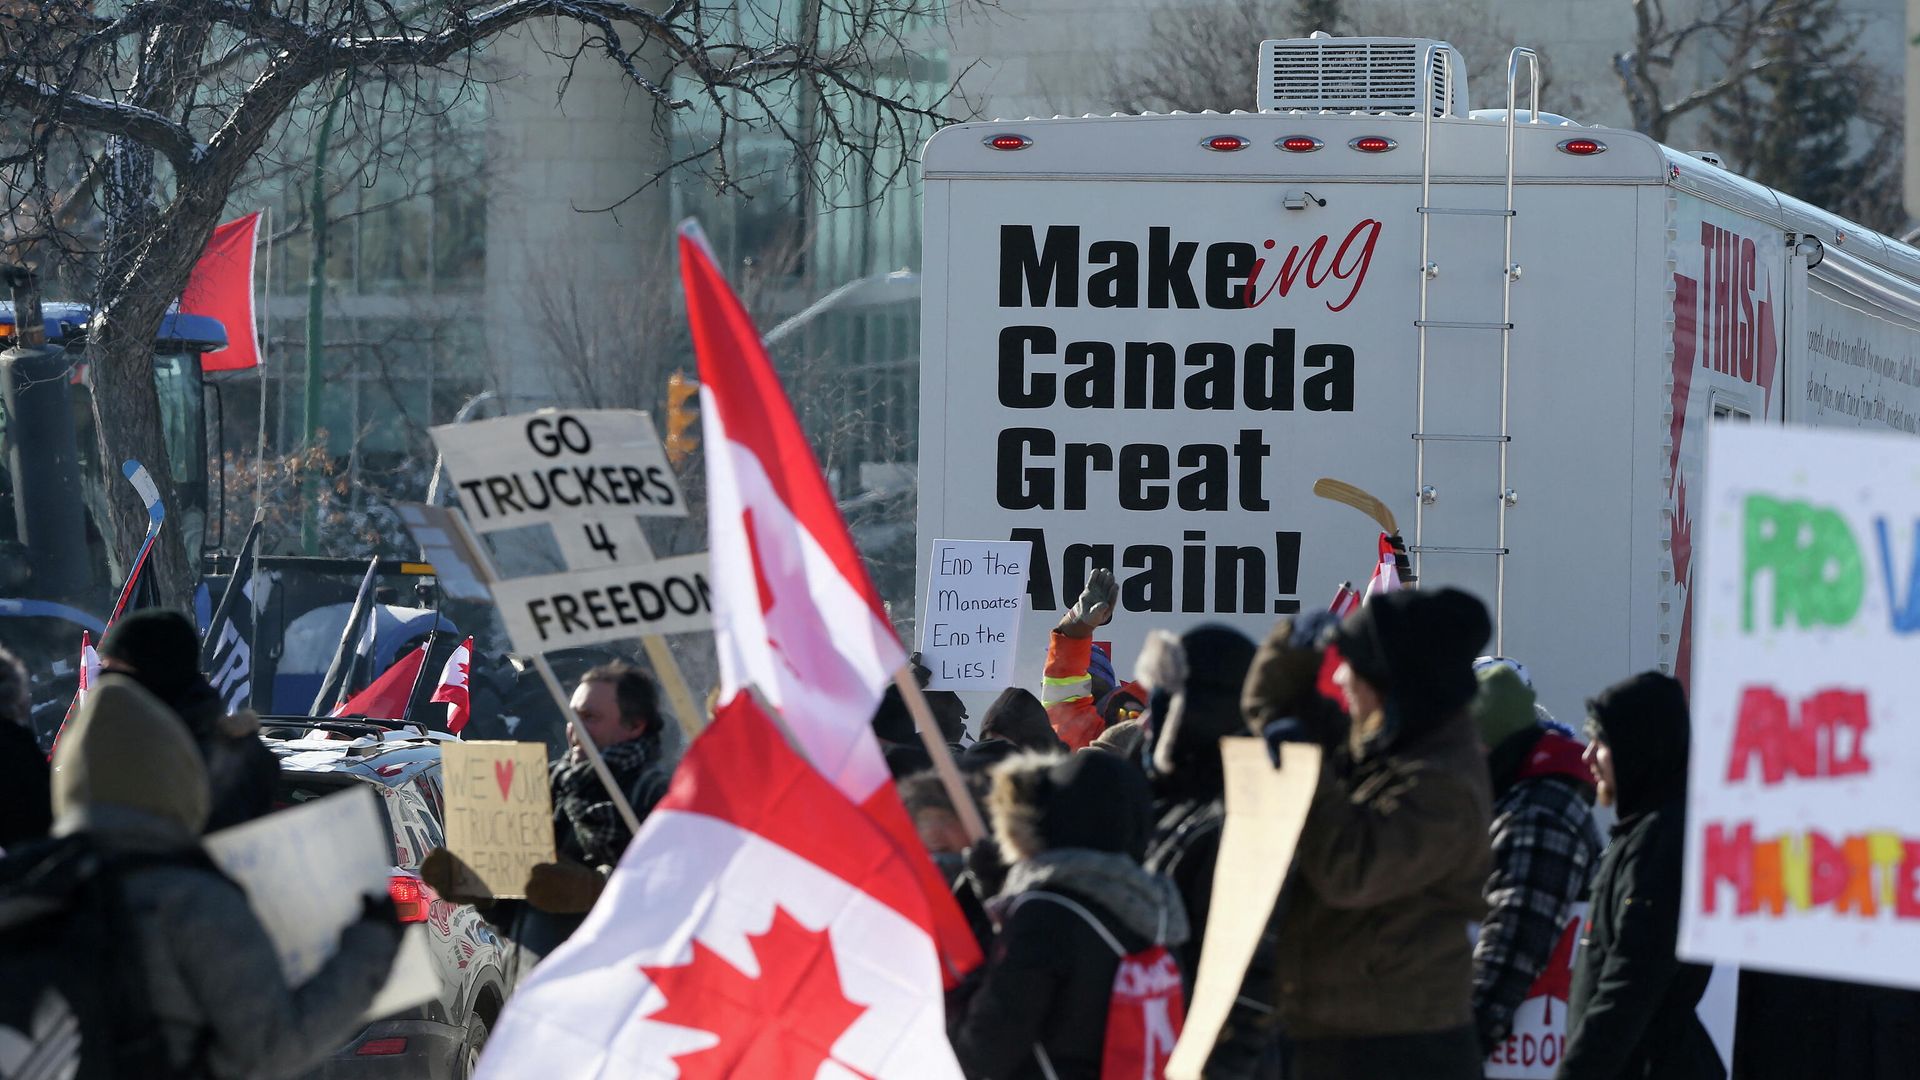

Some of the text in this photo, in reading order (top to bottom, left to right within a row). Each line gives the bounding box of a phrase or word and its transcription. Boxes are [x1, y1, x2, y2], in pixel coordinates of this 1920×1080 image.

[1701, 221, 1756, 383] THIS
[998, 326, 1354, 412] Canada
[526, 415, 592, 458] GO
[460, 465, 675, 518] TRUCKERS
[997, 427, 1270, 511] Great
[583, 523, 618, 562] 4
[982, 550, 1020, 576] the
[1740, 490, 1866, 635] PRO
[976, 624, 1006, 644] the
[1724, 683, 1871, 785] ANTI
[446, 755, 548, 805] WE OUR
[455, 808, 554, 847] TRUCKERS
